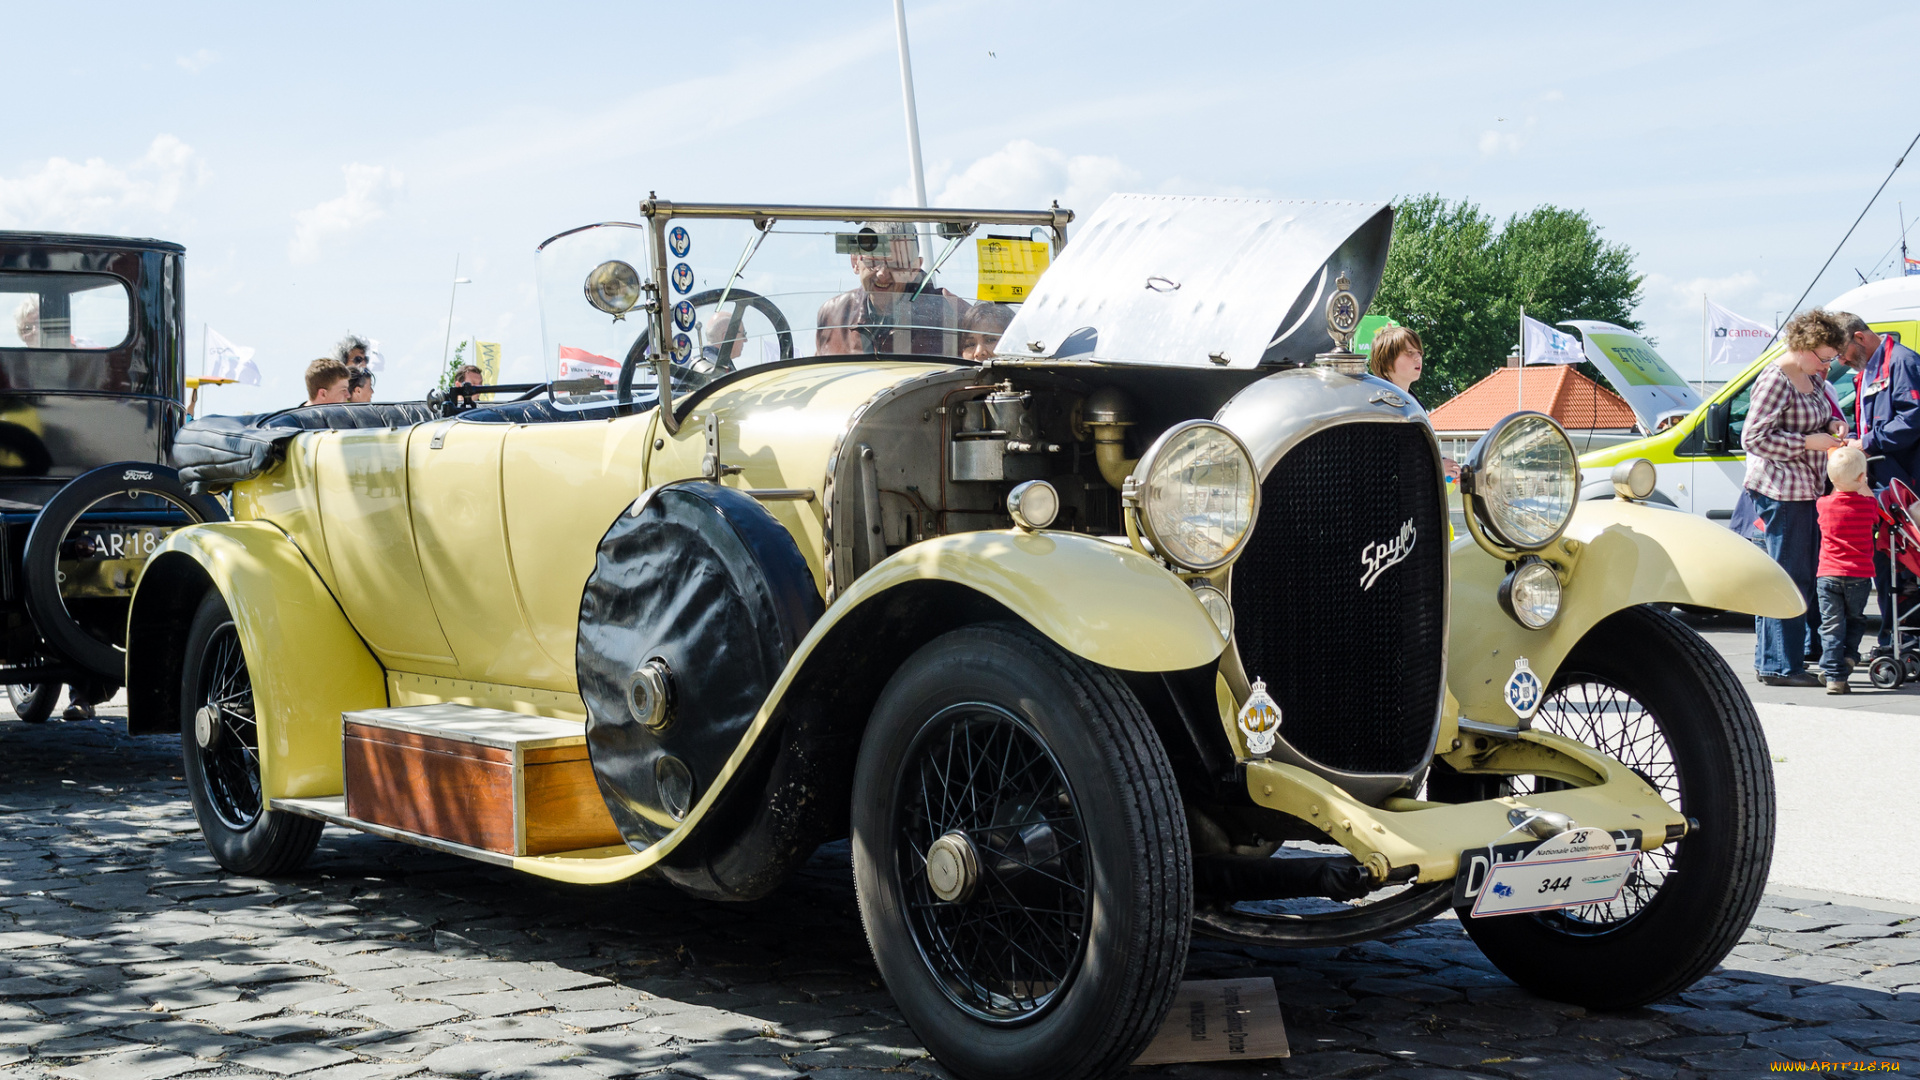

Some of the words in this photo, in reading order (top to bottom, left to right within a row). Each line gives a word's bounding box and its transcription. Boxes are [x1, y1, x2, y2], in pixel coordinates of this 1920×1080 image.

[123, 469, 153, 480] Ford
[1360, 517, 1417, 591] Spyker
[1536, 846, 1568, 857] Nationale
[1569, 843, 1612, 854] Oldtimerdag
[1538, 876, 1573, 893] 344
